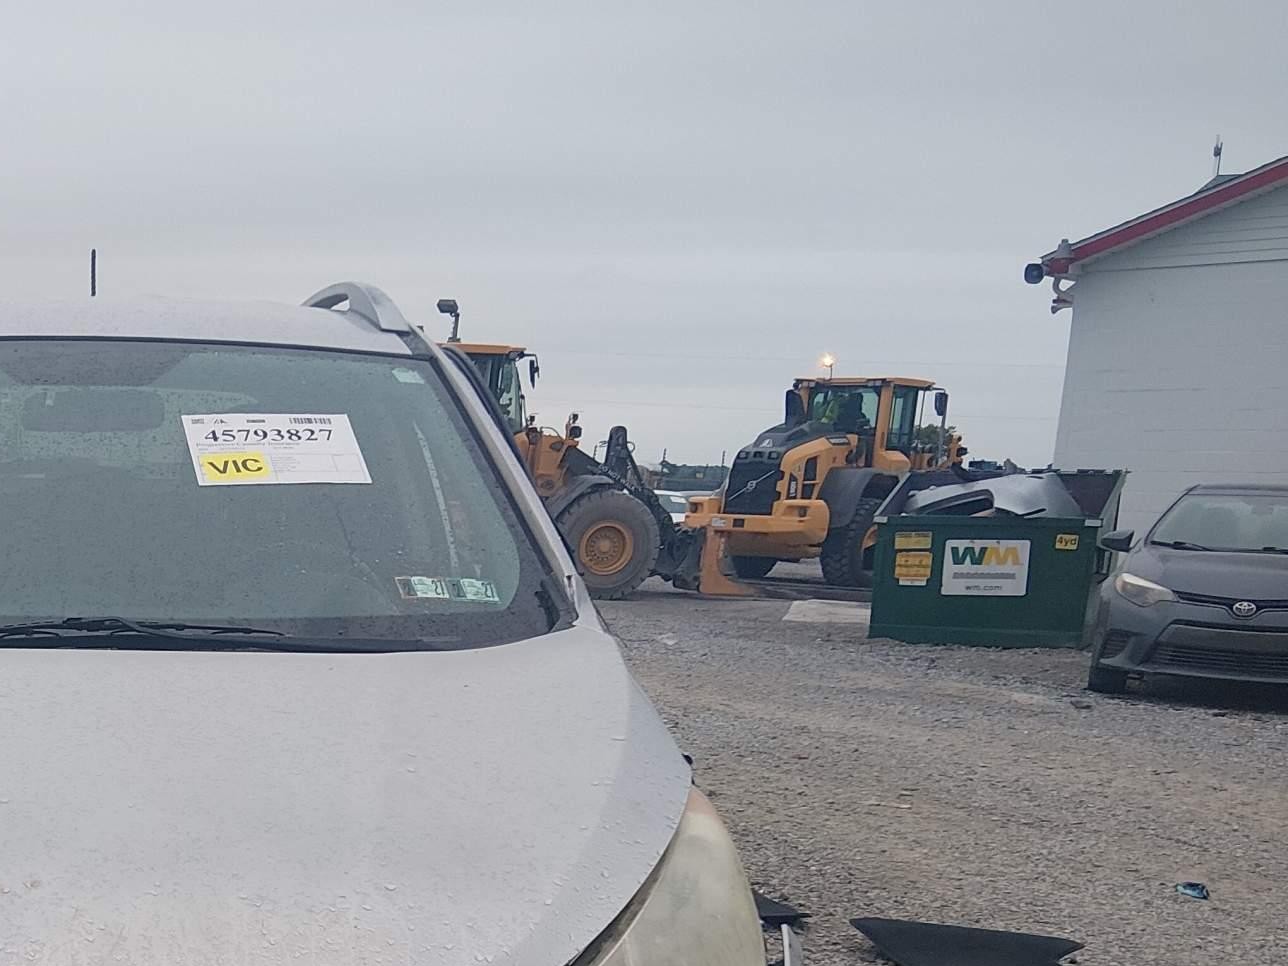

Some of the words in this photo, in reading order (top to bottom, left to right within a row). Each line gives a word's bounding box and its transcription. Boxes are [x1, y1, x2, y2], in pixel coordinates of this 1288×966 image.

[204, 428, 333, 443] 45793827
[207, 458, 264, 475] VIC
[1057, 536, 1078, 547] 4yd
[951, 546, 1023, 566] WM
